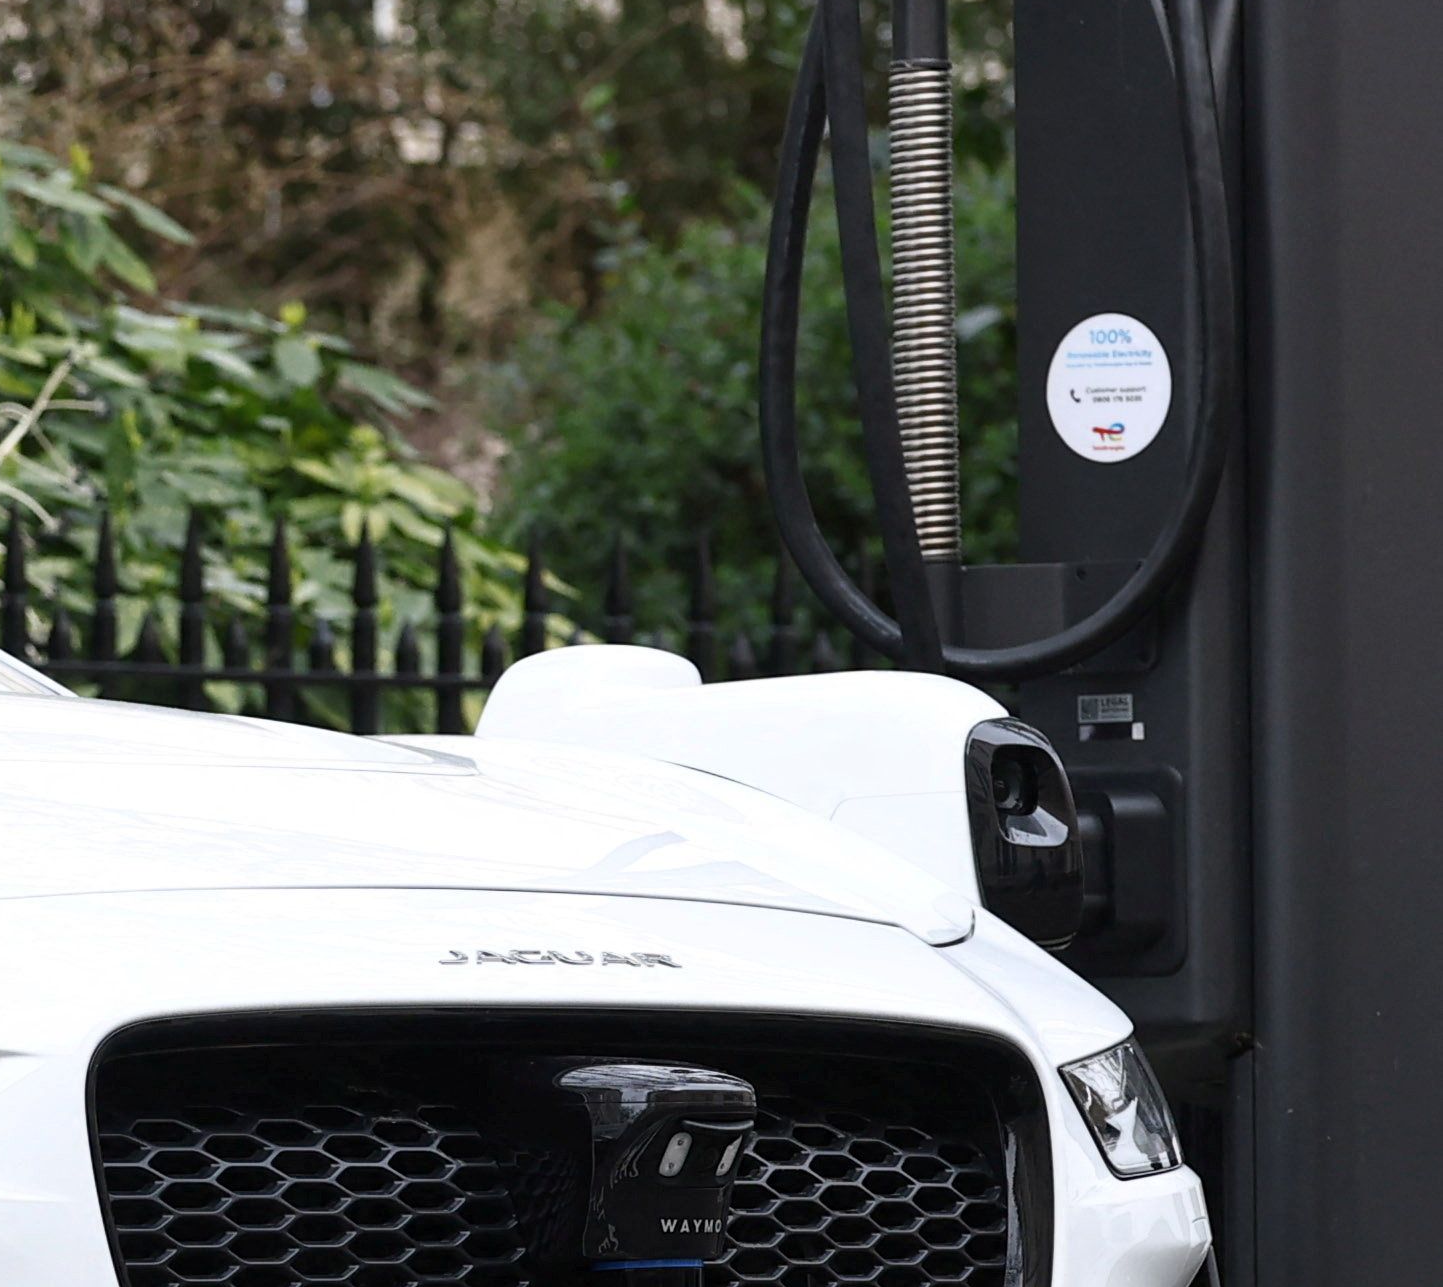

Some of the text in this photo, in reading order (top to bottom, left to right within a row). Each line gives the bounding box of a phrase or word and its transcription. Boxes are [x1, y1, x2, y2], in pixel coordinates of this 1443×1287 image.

[1089, 329, 1133, 344] 100%
[438, 948, 683, 969] JAGUAR
[660, 1218, 722, 1233] WAYMO
